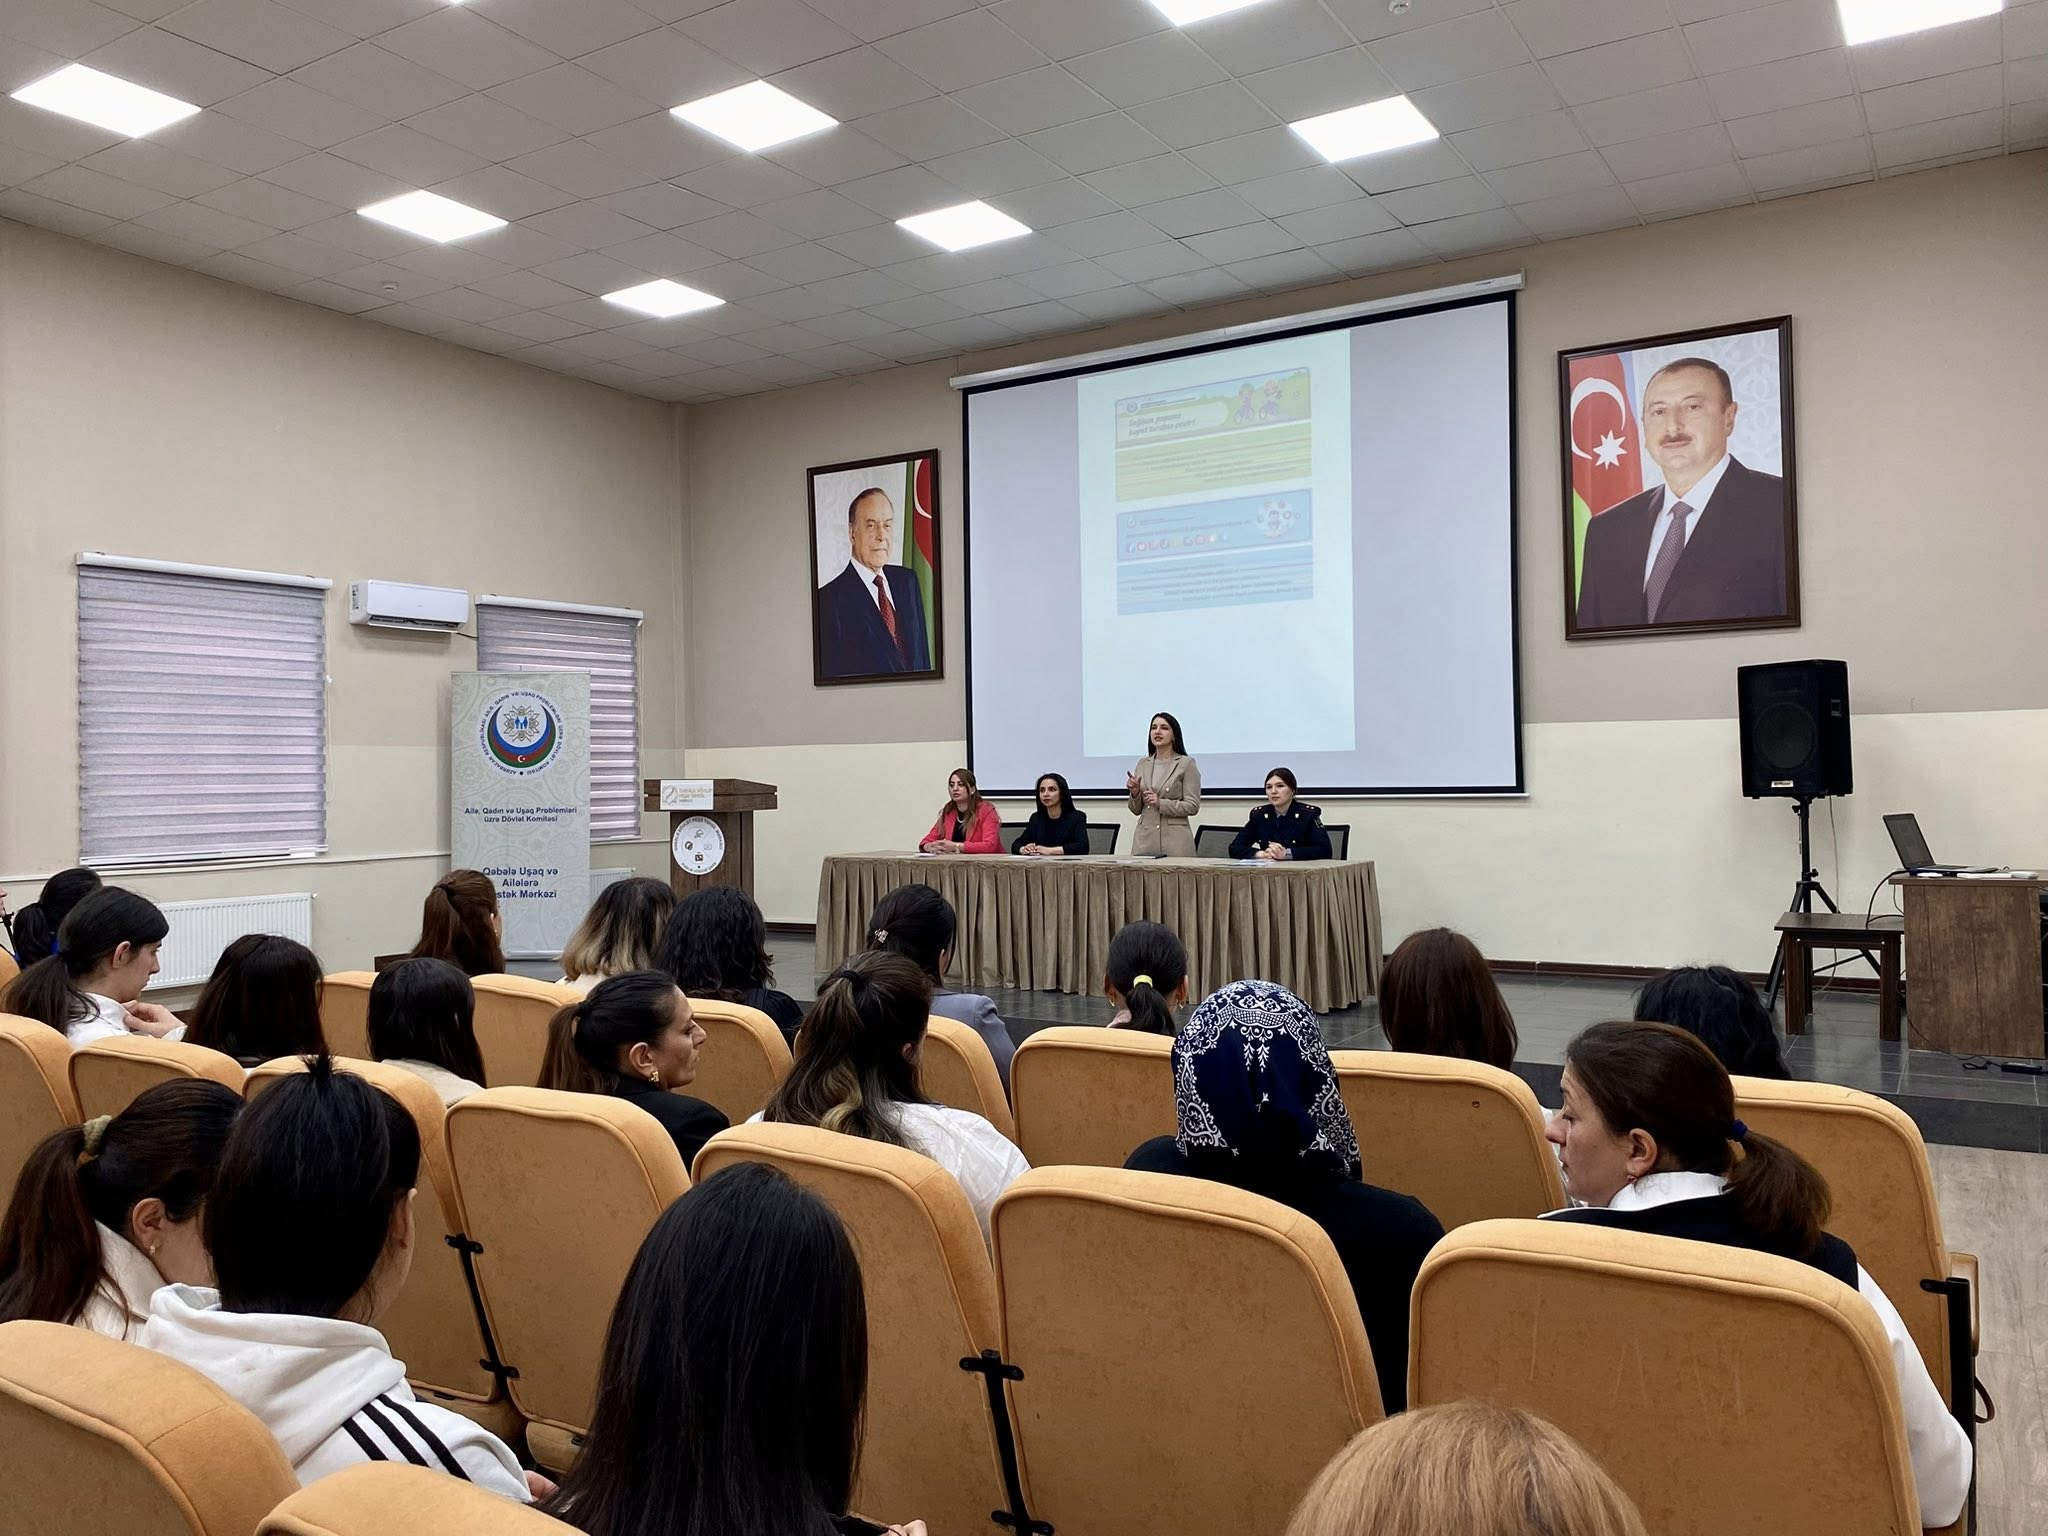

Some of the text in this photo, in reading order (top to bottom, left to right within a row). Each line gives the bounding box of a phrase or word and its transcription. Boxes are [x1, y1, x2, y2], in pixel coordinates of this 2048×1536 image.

[482, 807, 504, 815] Qadın
[516, 807, 534, 815] Uşaq
[536, 806, 577, 814] Problemləri
[483, 867, 516, 876] Qəbələ
[519, 867, 544, 877] Uşaq
[502, 879, 539, 887] Ailələrə
[496, 890, 557, 898] stək Mərkəzi
